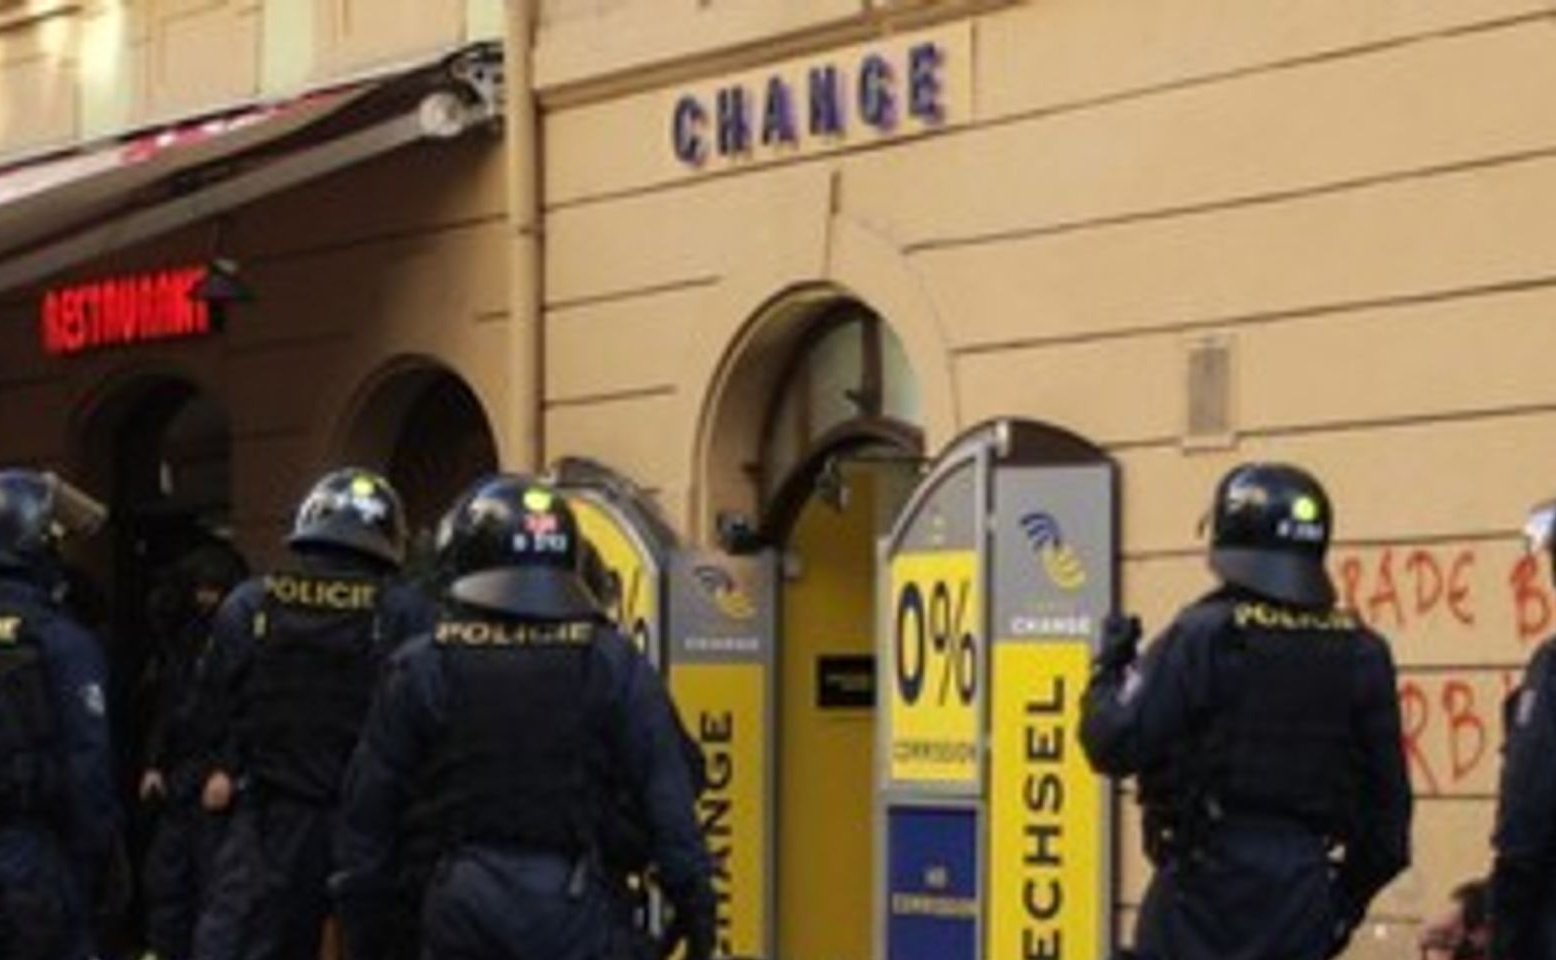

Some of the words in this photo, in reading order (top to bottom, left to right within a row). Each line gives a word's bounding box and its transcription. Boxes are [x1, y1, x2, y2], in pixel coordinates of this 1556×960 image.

[673, 40, 945, 168] CHANGE
[43, 266, 210, 354] RESTAURANT
[895, 580, 978, 707] 0%
[1010, 615, 1091, 636] CHANGE
